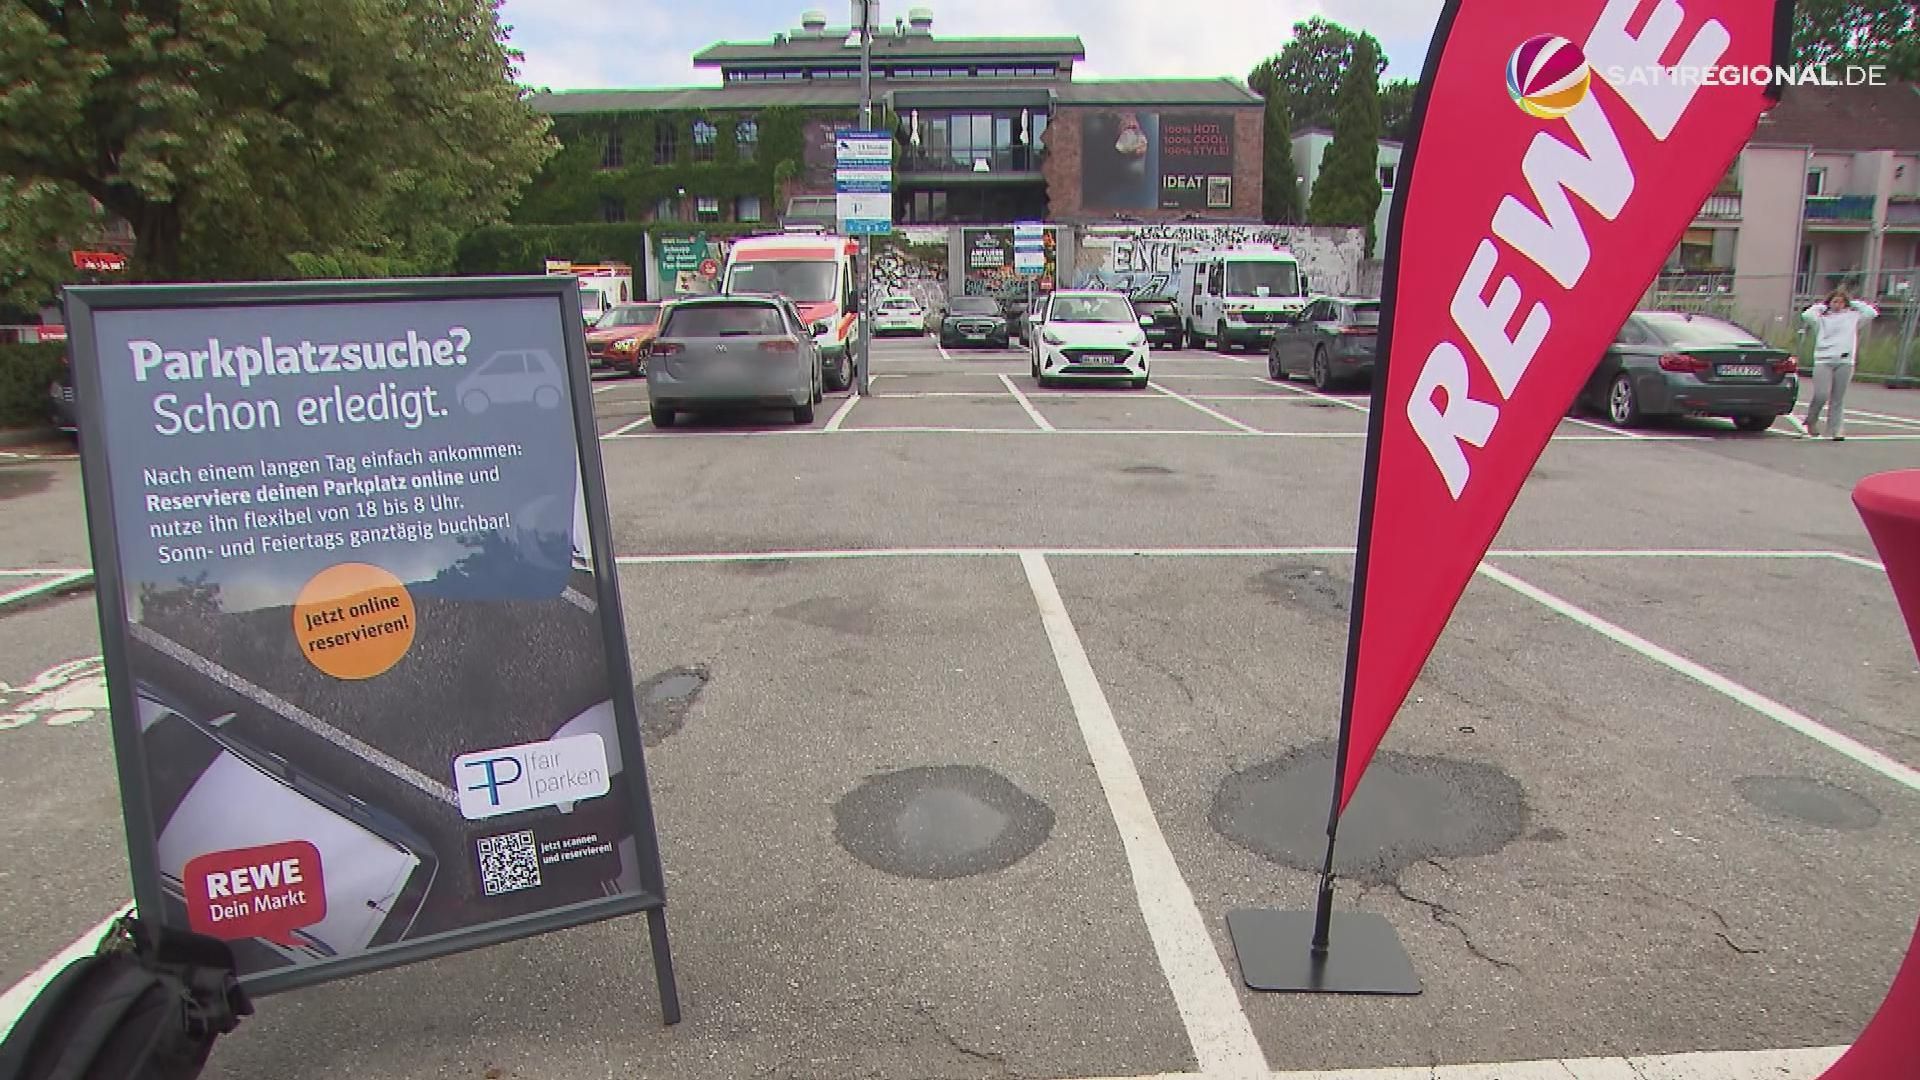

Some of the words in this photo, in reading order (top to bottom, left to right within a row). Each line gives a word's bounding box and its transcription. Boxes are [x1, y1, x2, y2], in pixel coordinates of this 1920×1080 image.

[1193, 134, 1229, 144] COOL!
[1194, 124, 1220, 134] HOT!
[1193, 145, 1229, 155] STYLE!
[1163, 174, 1204, 189] IDEAT
[1407, 0, 1731, 500] REWE
[128, 327, 472, 387] Parkplatzsuche?
[153, 392, 281, 435] Schon
[297, 382, 449, 428] erledigt.
[144, 466, 192, 487] Nach
[198, 463, 254, 482] einem
[260, 458, 321, 478] langen
[325, 454, 356, 474] Tag
[362, 448, 423, 469] einfach
[429, 444, 522, 464] ankommen:
[146, 488, 251, 512] Reserviere
[256, 483, 319, 502] deinen
[323, 474, 408, 498] Parkplatz
[411, 470, 464, 489] online
[469, 465, 500, 484] und
[150, 519, 202, 538] nutze
[209, 514, 238, 533] ihn
[244, 506, 312, 530] flexibel
[317, 506, 349, 522] von
[356, 500, 378, 518] 18
[383, 498, 408, 516] bis
[414, 497, 425, 513] 8
[431, 494, 465, 512] Uhr.
[158, 543, 214, 564] Sonn-
[221, 537, 255, 558] und
[261, 532, 344, 554] Feiertags
[350, 520, 434, 548] ganztägig
[438, 513, 511, 535] buchbar!
[305, 606, 345, 631] Jetzt
[349, 596, 400, 618] online
[308, 614, 409, 652] reservieren!
[530, 751, 561, 771] fair
[535, 768, 600, 798] parken
[541, 839, 561, 855] Jetzt
[563, 834, 598, 848] scannen
[542, 854, 560, 865] und
[561, 842, 613, 860] reservieren!
[206, 858, 303, 900] REWE
[209, 900, 249, 922] Dein
[254, 890, 307, 914] Markt
